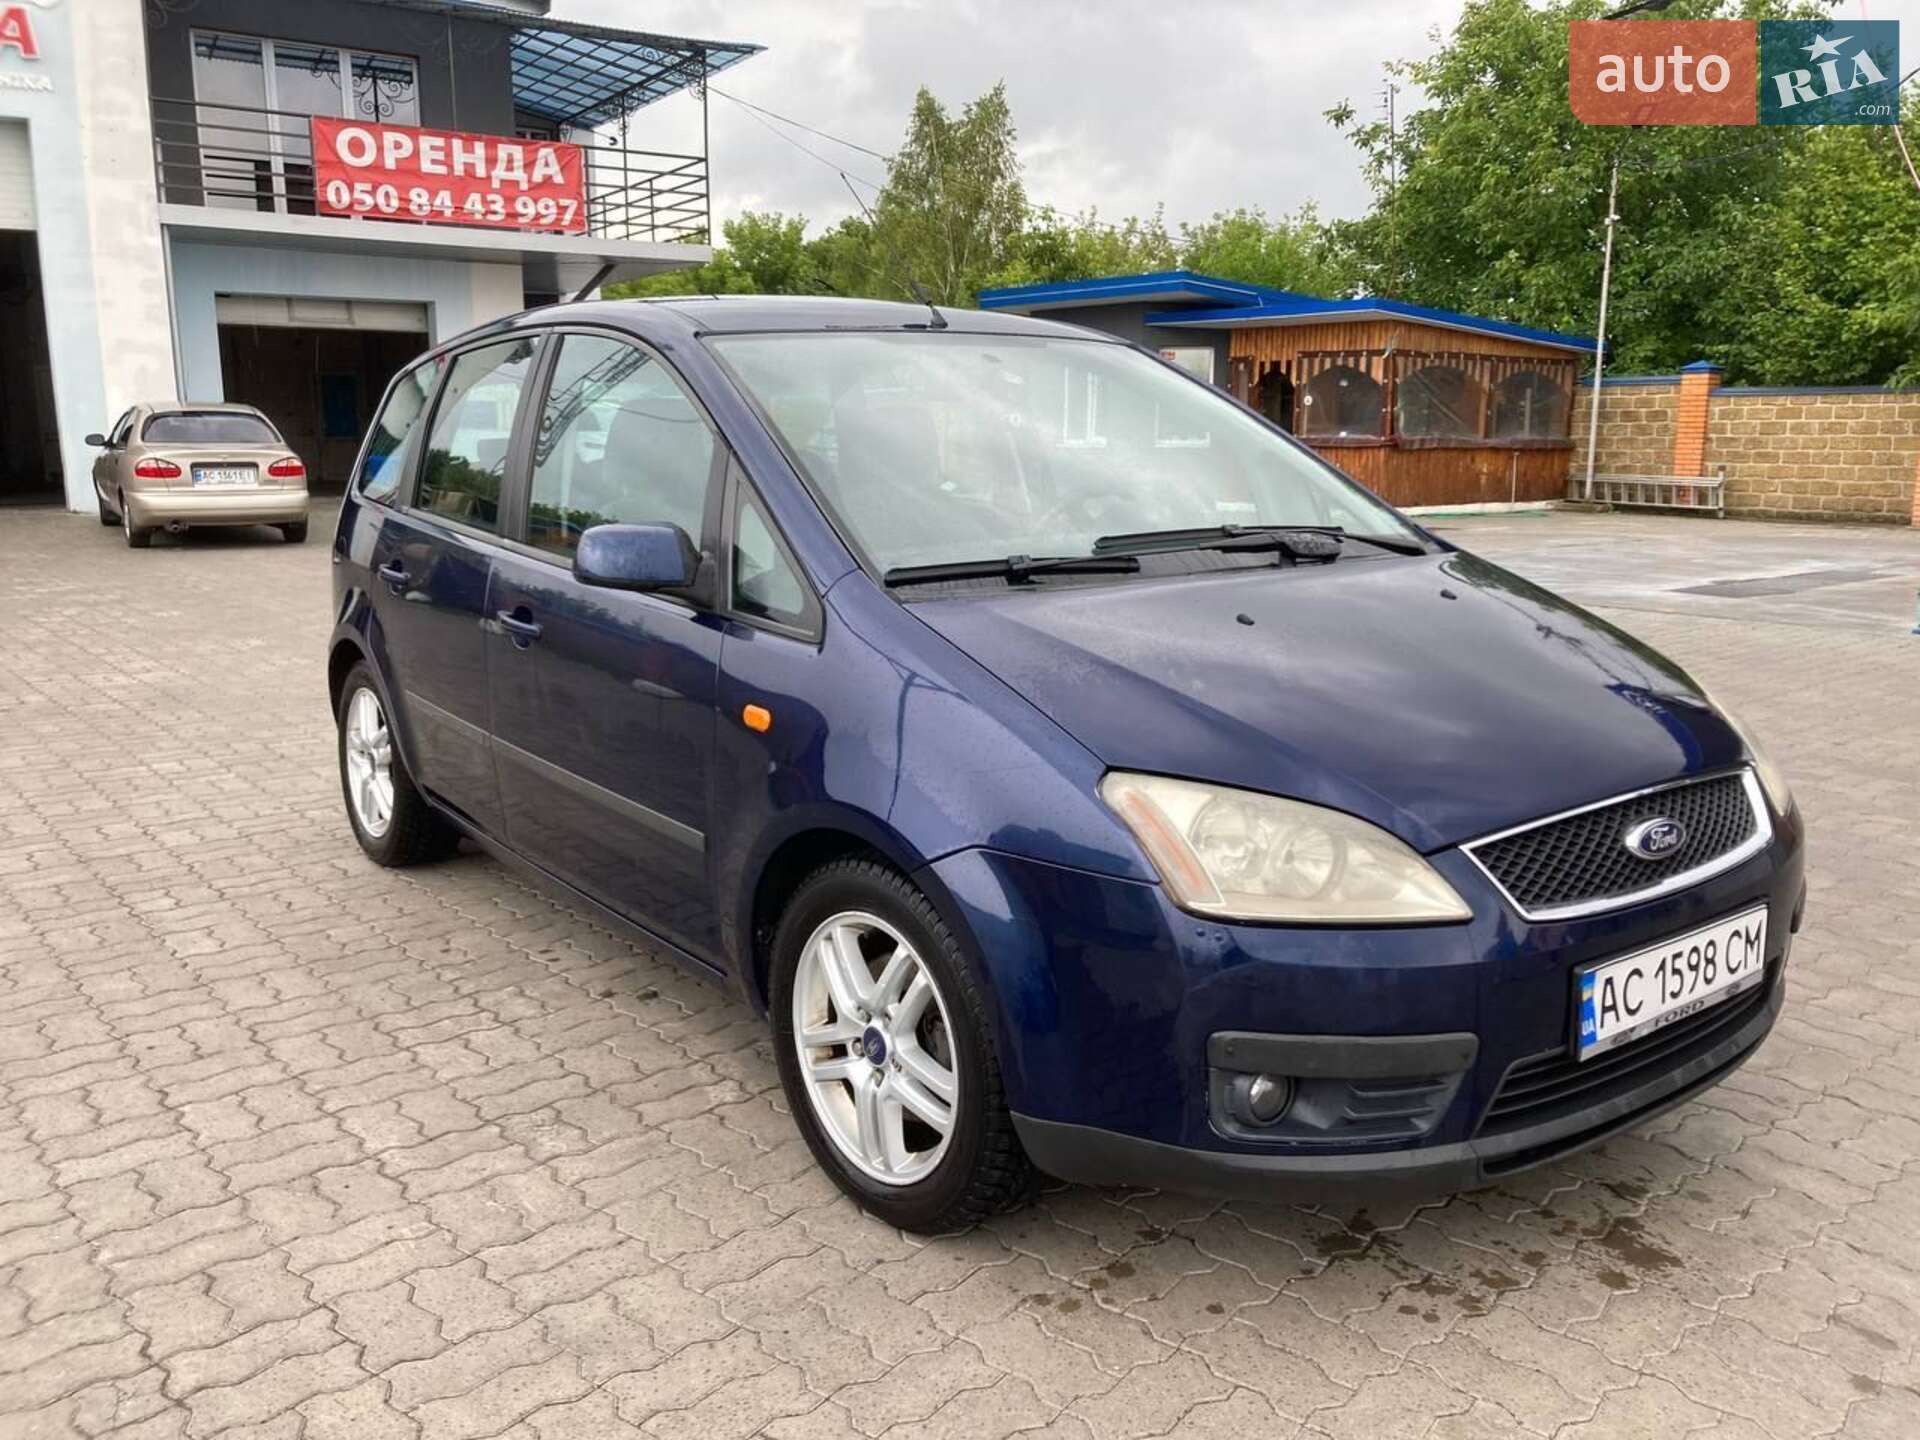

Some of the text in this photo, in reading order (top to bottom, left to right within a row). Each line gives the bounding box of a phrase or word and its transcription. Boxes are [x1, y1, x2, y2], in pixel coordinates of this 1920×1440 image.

[335, 127, 565, 191] ОРЕНДА
[326, 179, 578, 226] 050 84 43 997
[1650, 826, 1677, 850] Ford
[1600, 919, 1762, 1029] AC 1598 CM
[1581, 1018, 1595, 1036] UA
[1654, 999, 1705, 1027] FORD
